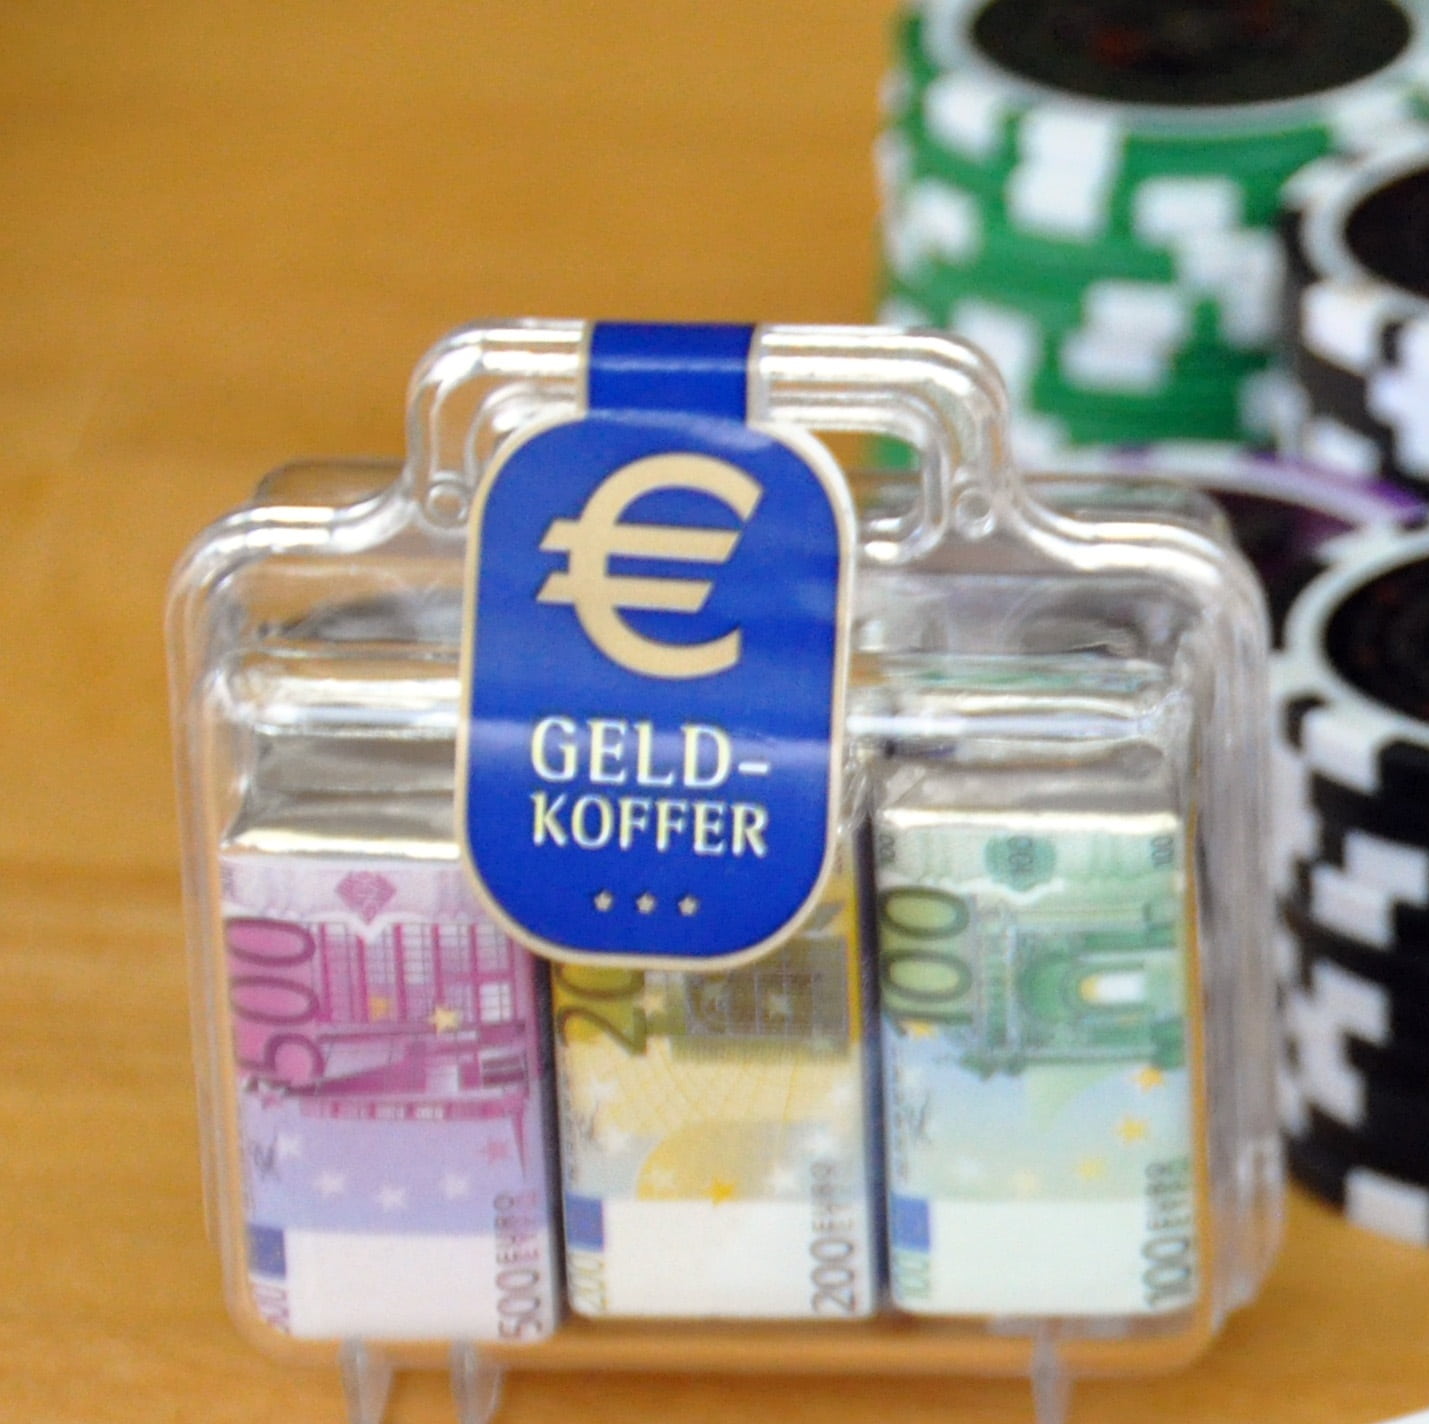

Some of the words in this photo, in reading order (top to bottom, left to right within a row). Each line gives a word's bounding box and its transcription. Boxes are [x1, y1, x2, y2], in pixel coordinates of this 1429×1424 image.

[530, 715, 772, 788] GELD-
[529, 791, 770, 858] KOFFER
[878, 885, 973, 1037] 100
[223, 915, 326, 1098] 500
[809, 1237, 857, 1313] 200
